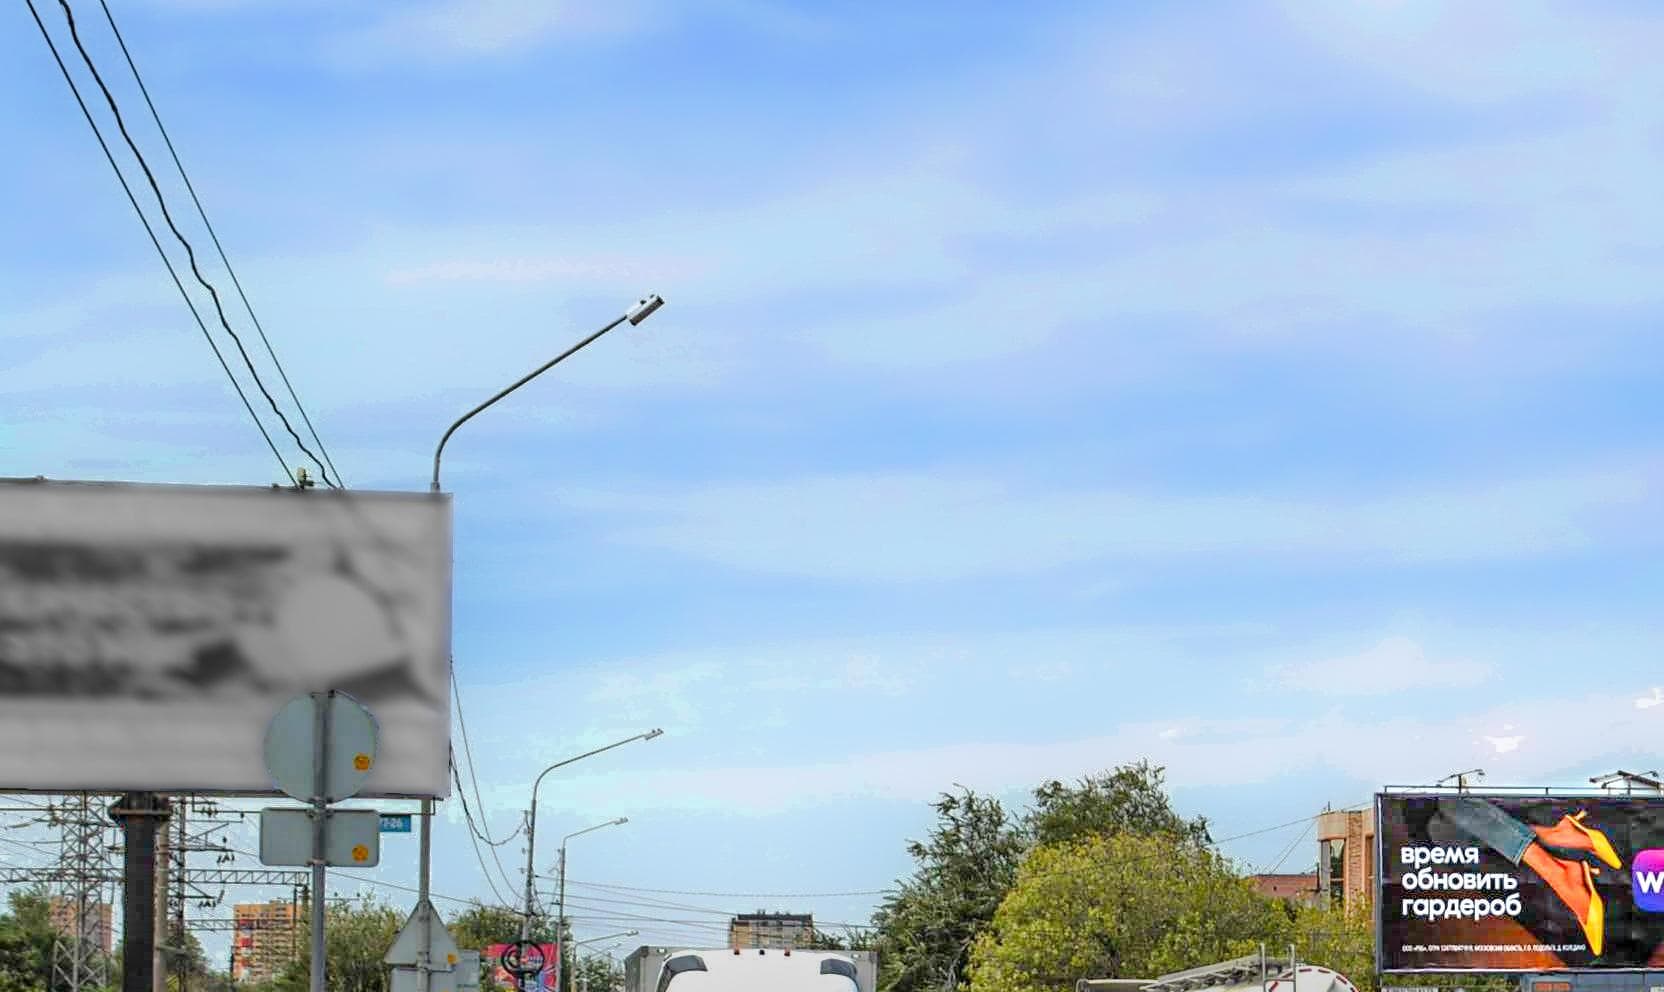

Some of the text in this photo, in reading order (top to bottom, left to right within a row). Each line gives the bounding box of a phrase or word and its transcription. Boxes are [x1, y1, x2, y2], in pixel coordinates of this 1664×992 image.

[1401, 846, 1479, 869] время
[1402, 866, 1519, 890] обновить
[1402, 892, 1521, 921] гардероб
